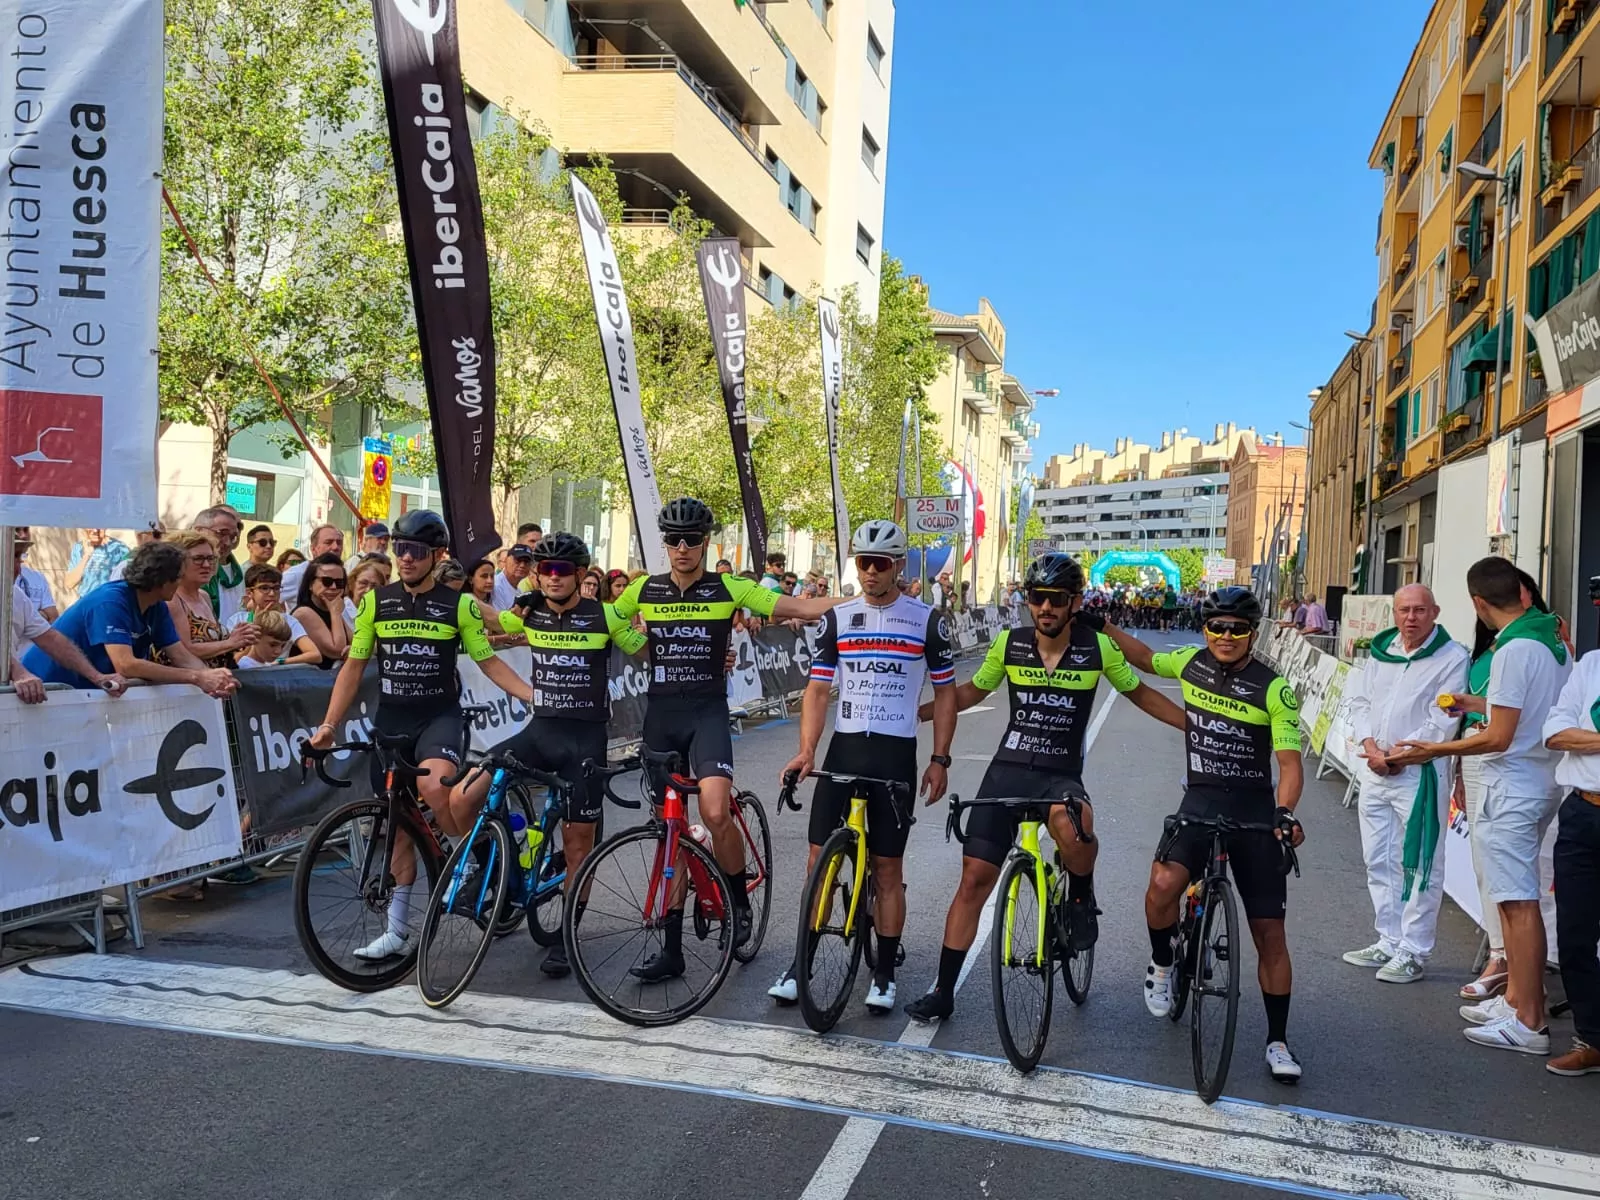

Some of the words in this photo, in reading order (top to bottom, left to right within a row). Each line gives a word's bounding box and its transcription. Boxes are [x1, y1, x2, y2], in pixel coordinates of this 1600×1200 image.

[414, 82, 466, 290] iberCaja
[0, 13, 52, 375] Ayuntamiento
[58, 102, 107, 300] Huesca
[58, 322, 105, 379] de
[473, 424, 483, 456] DEL
[945, 499, 959, 512] M
[654, 603, 711, 614] LOURIÑA
[384, 620, 440, 633] LOURIÑA
[663, 626, 712, 638] LASAL
[534, 631, 589, 642] LOURIÑA
[392, 643, 440, 656] LASAL
[542, 654, 591, 667] LASAL
[755, 644, 791, 675] berCaja
[667, 666, 695, 674] XUNTA
[857, 661, 908, 675] LASAL
[667, 674, 678, 682] DE
[679, 673, 713, 682] GALICIA
[393, 681, 424, 689] XUNTA
[544, 692, 574, 700] XUNTA
[1028, 692, 1077, 709] LASAL
[1191, 687, 1249, 714] LOURIÑA
[463, 688, 530, 731] iberC
[555, 701, 594, 709] GALICIA
[854, 704, 886, 713] XUNTA
[853, 711, 865, 720] DE
[868, 712, 905, 721] GALICIA
[1199, 714, 1252, 739] LASAL
[1022, 734, 1052, 745] XUNTA
[1019, 743, 1032, 751] DE
[1032, 745, 1068, 755] GALICIA
[1202, 757, 1241, 770] XUNTA
[1204, 765, 1218, 774] DE
[1221, 769, 1264, 778] GALICIA
[0, 750, 103, 842] aja
